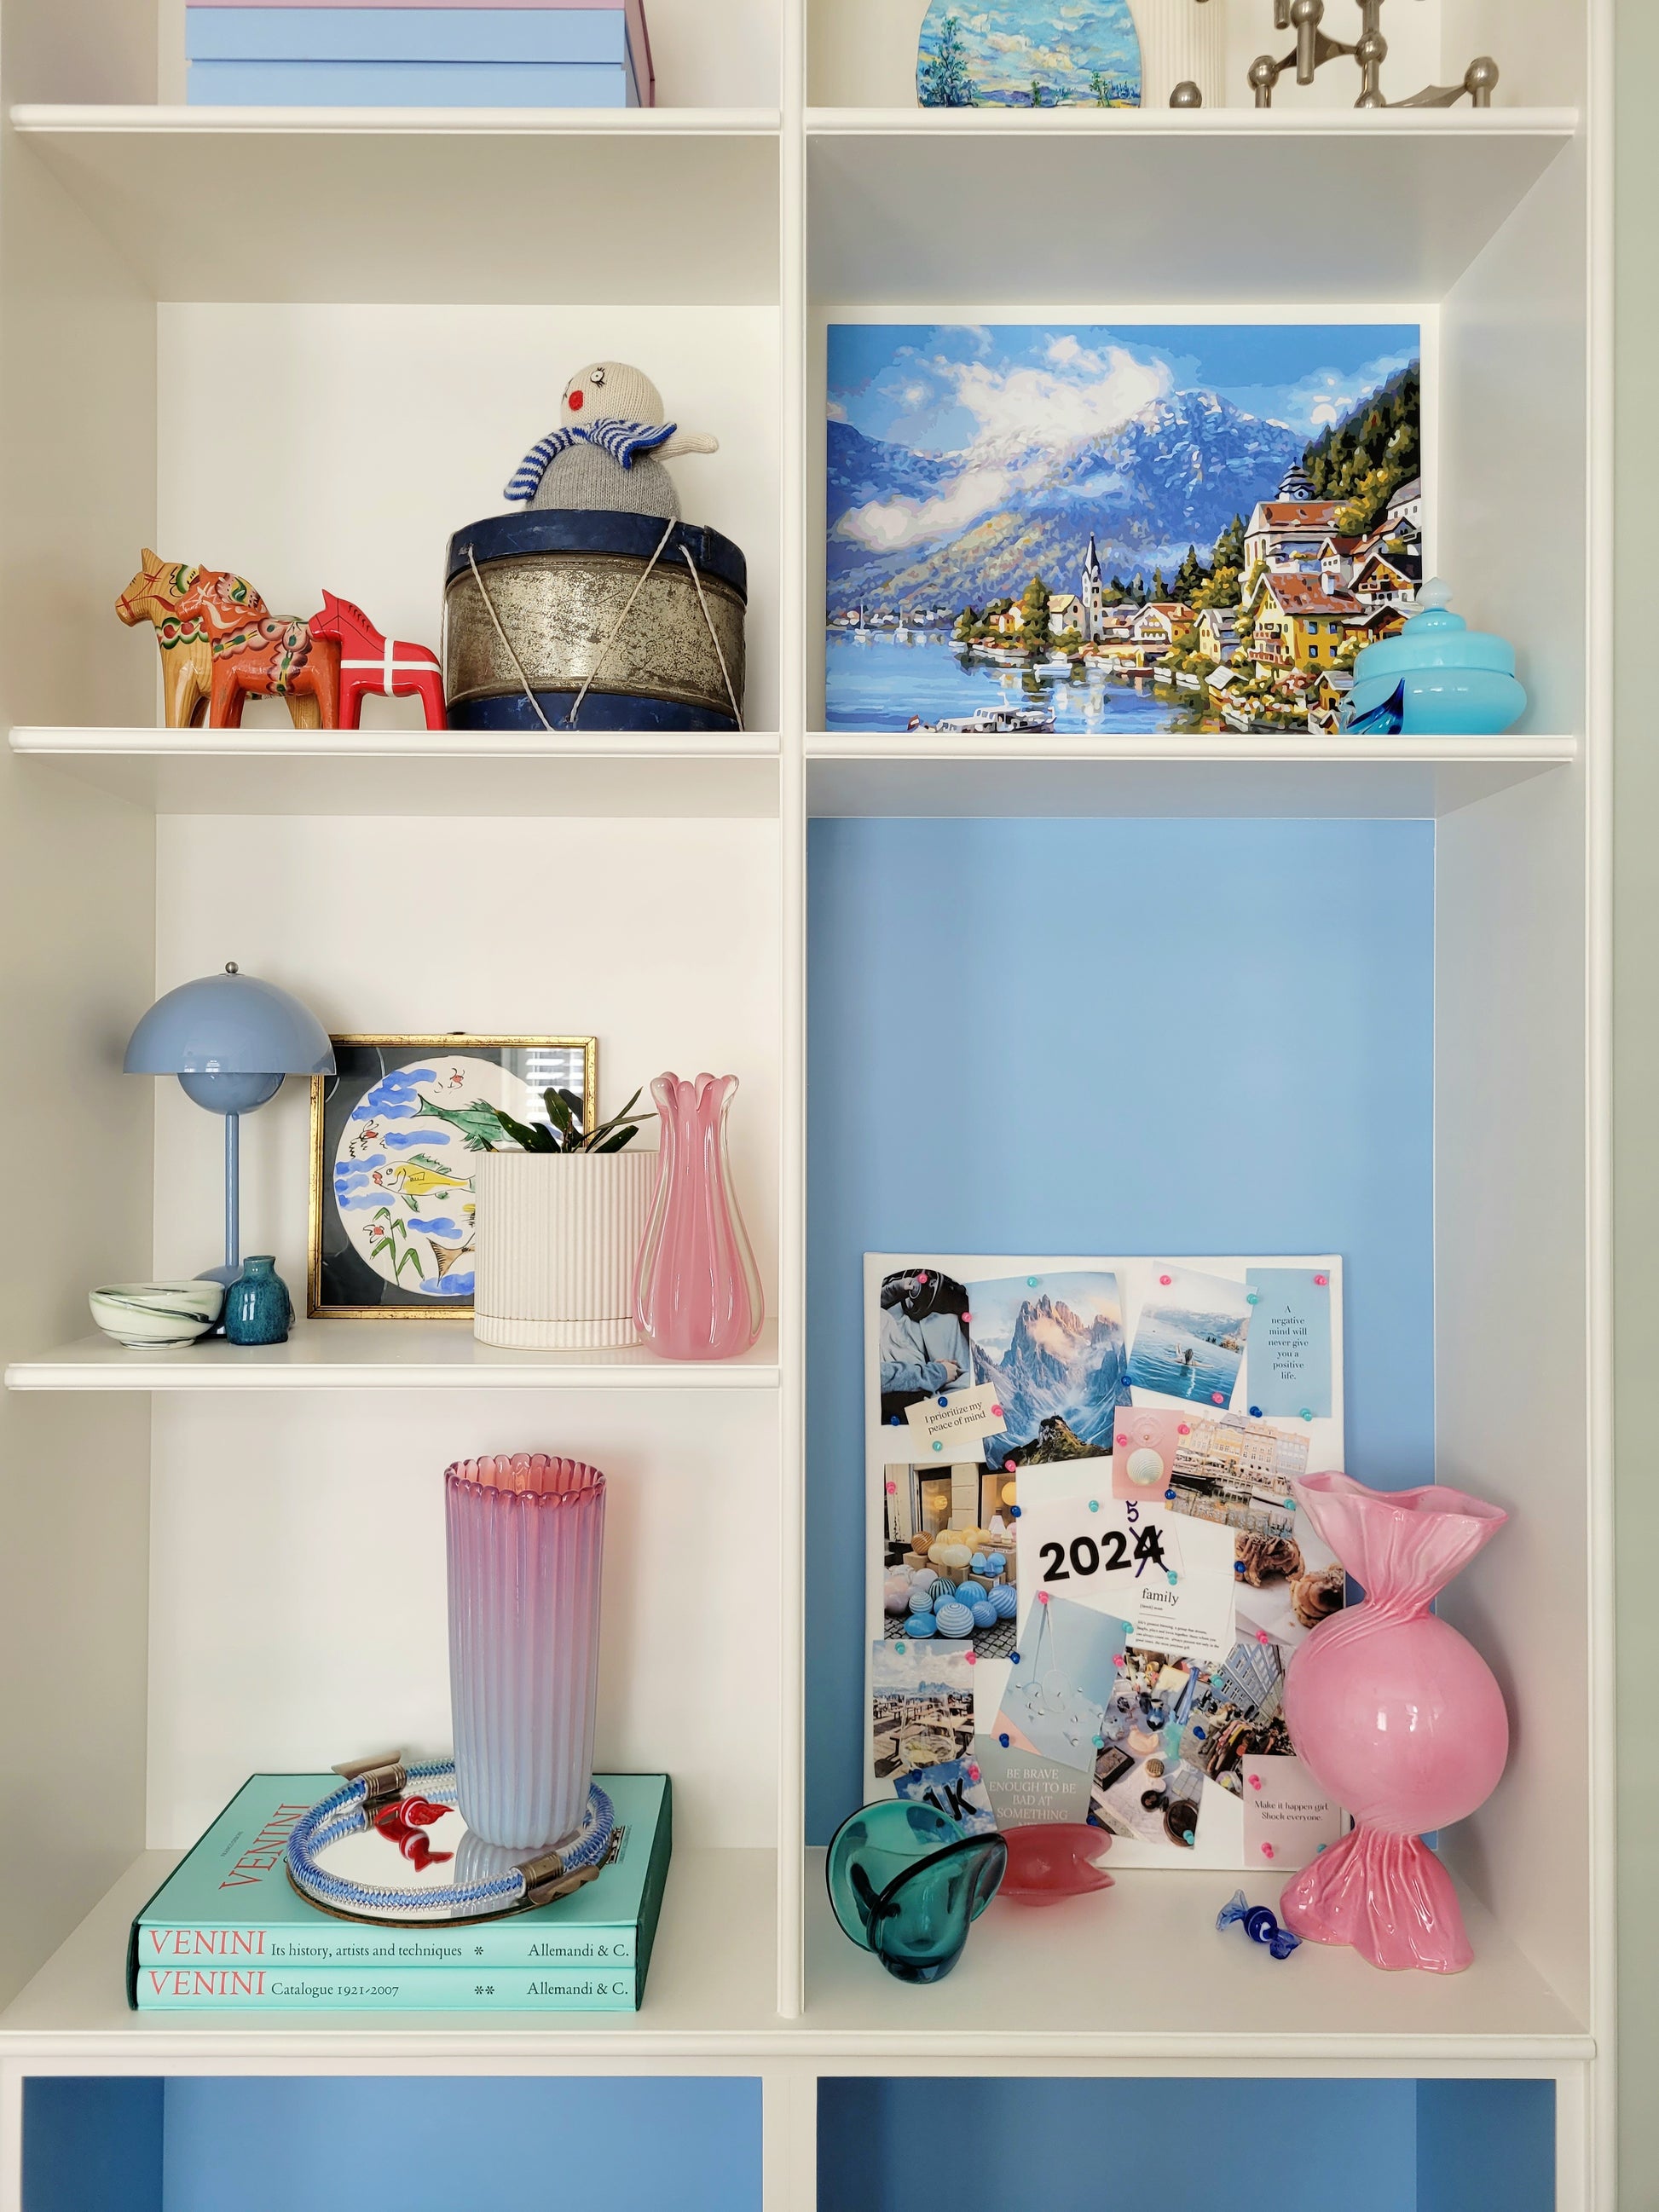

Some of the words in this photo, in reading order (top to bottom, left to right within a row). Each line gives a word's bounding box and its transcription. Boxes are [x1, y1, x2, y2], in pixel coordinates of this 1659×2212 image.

[1285, 1305, 1292, 1314] A
[1271, 1316, 1305, 1326] negative
[1269, 1327, 1291, 1336] mind
[1292, 1327, 1308, 1336] will
[1292, 1337, 1309, 1349] give
[1277, 1351, 1292, 1360] you
[1273, 1360, 1304, 1371] positive
[1281, 1371, 1297, 1380] life.
[928, 1406, 968, 1424] prioritize
[969, 1402, 982, 1412] my
[928, 1421, 953, 1435] peace
[953, 1418, 962, 1427] of
[964, 1411, 986, 1424] mind
[1126, 1500, 1140, 1523] 5
[1142, 1588, 1179, 1607] family
[1007, 1769, 1020, 1779] BE
[1023, 1769, 1059, 1780] BRAVE
[989, 1782, 1040, 1793] ENOUGH
[1042, 1782, 1060, 1793] TO
[1062, 1783, 1077, 1793] BE
[1012, 1794, 1036, 1806] BAD
[1038, 1795, 1053, 1806] AT
[1255, 1800, 1276, 1809] Make
[1285, 1802, 1313, 1811] happen
[997, 1808, 1068, 1821] SOMETHING
[1261, 1812, 1285, 1821] Shock
[218, 1803, 310, 1890] VENINI
[149, 1930, 267, 1955] VENINI
[271, 1943, 286, 1956] Its
[288, 1943, 332, 1960] history,
[336, 1943, 370, 1956] artists
[373, 1943, 396, 1956] and
[398, 1943, 462, 1960] techniques
[527, 1943, 594, 1957] Allemandi
[597, 1944, 610, 1957] &
[613, 1943, 630, 1957] C.
[148, 1971, 267, 1995] VENINI
[271, 1982, 334, 1999] Catalogue
[526, 1982, 593, 1995] Allemandi
[596, 1983, 609, 1995] &
[611, 1982, 629, 1995] C.
